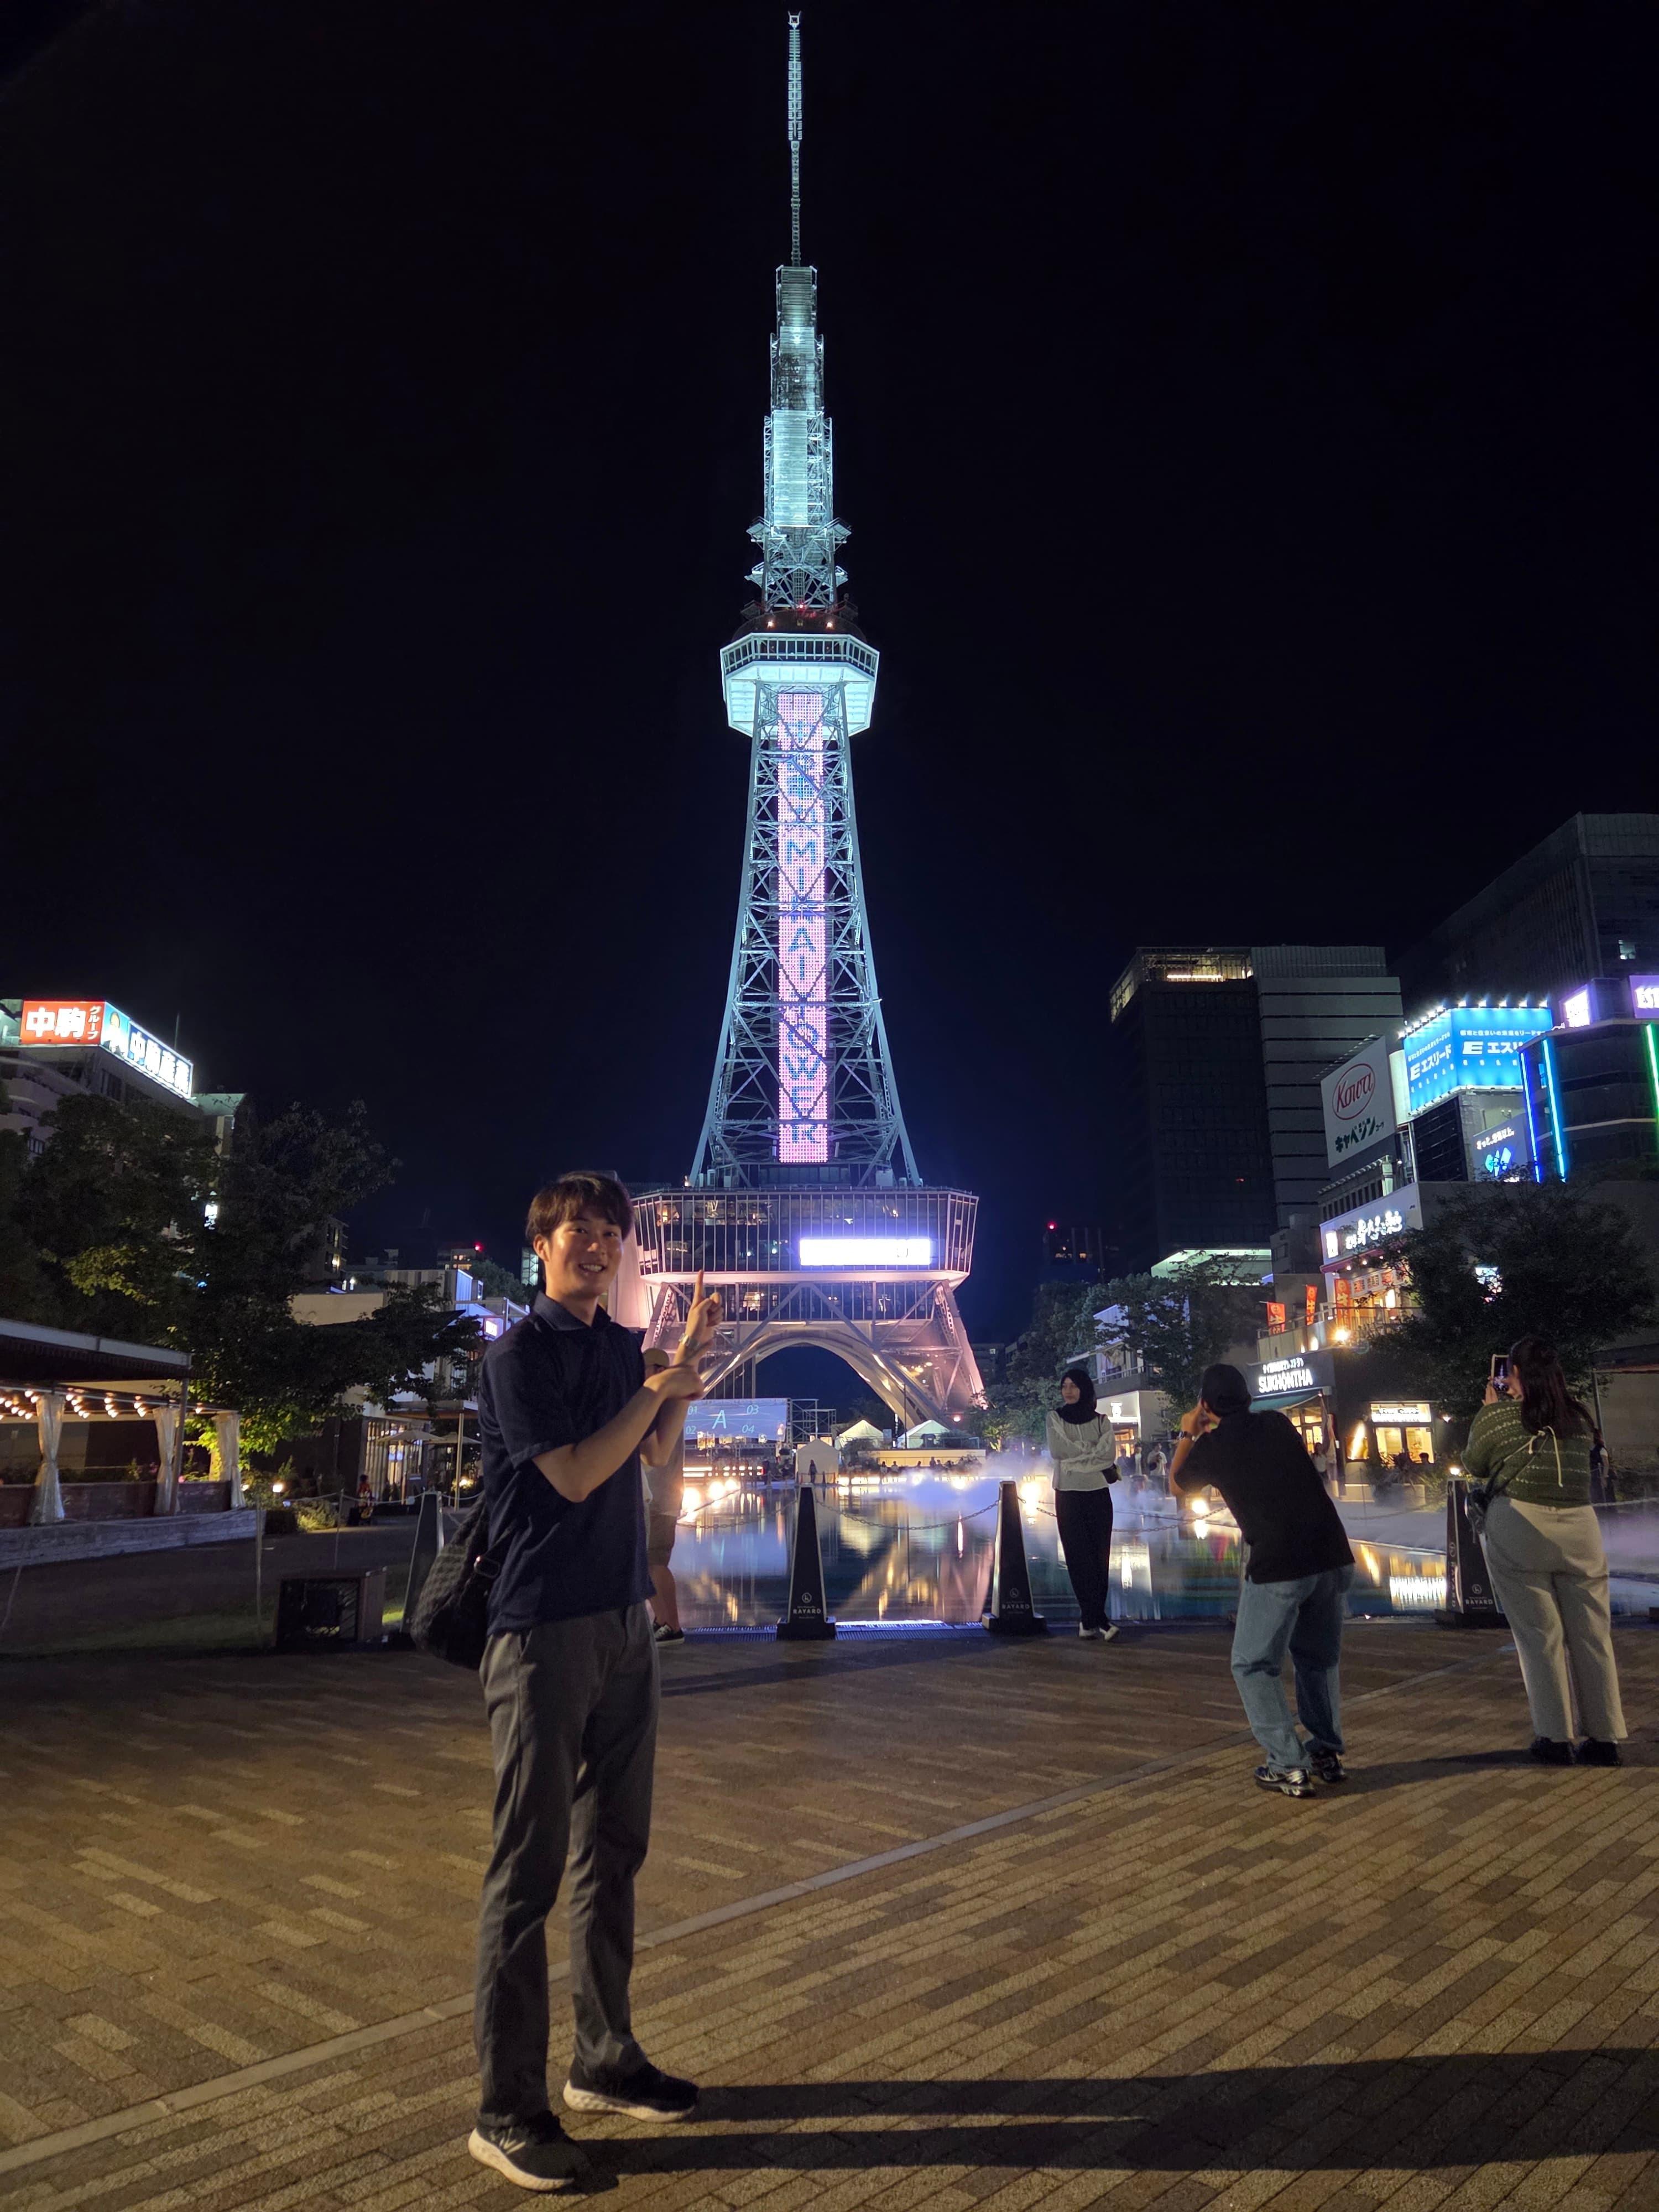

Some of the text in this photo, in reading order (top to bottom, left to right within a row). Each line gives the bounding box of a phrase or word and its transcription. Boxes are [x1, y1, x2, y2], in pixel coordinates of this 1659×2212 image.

[26, 1008, 86, 1037] 中駒
[87, 1006, 102, 1040] グループ
[1488, 1042, 1524, 1053] エスリ
[1421, 1044, 1452, 1073] エスリード
[1337, 1073, 1373, 1112] Kowa
[1259, 1369, 1313, 1393] SUKHONTHA
[687, 1406, 698, 1415] 01
[712, 1410, 727, 1429] A
[747, 1405, 759, 1415] 03
[685, 1426, 696, 1434] 02
[742, 1425, 755, 1433] 04
